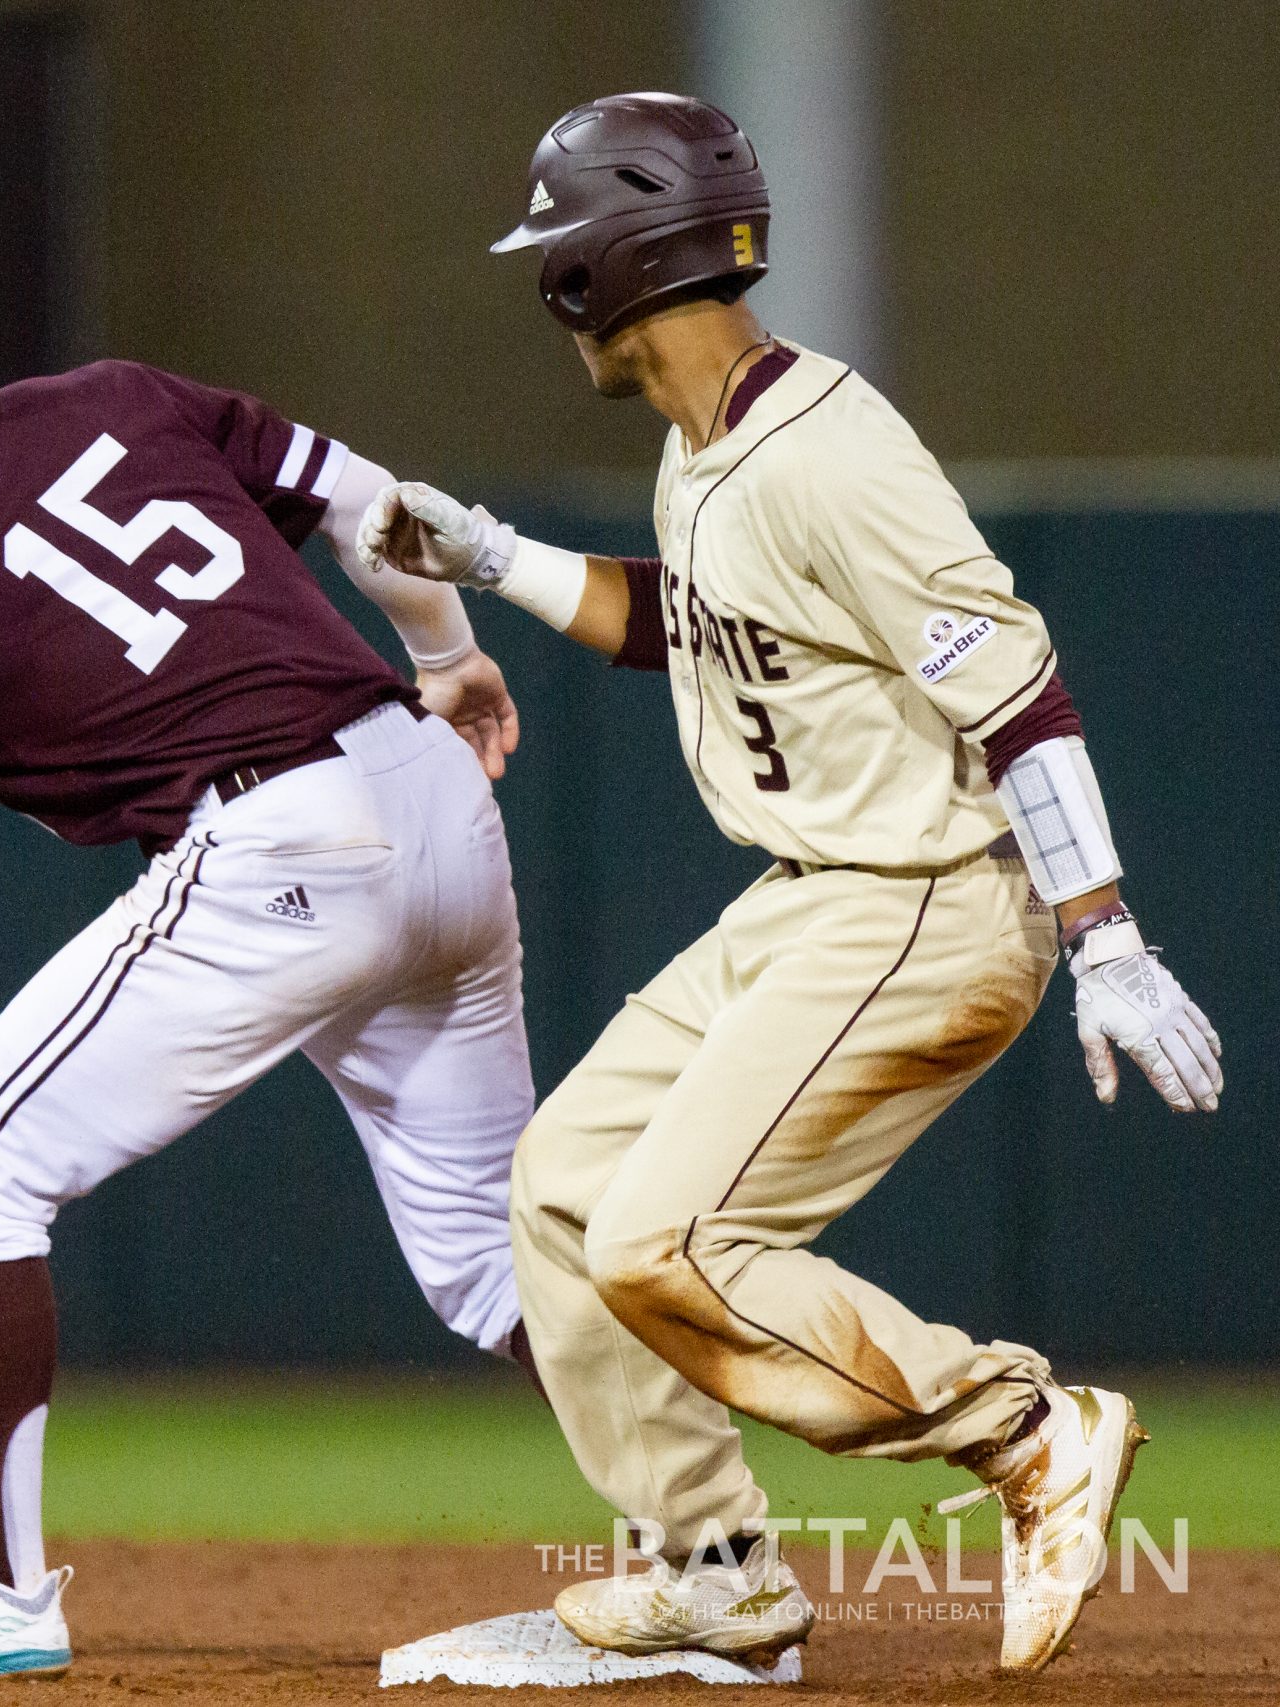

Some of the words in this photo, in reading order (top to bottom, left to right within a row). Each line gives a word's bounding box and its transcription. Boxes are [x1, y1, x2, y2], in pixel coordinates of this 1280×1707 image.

[732, 223, 754, 267] 3
[4, 432, 245, 676] 15
[921, 649, 957, 679] SUN
[953, 620, 989, 653] BELT
[736, 695, 790, 792] 3
[265, 902, 316, 922] adidas
